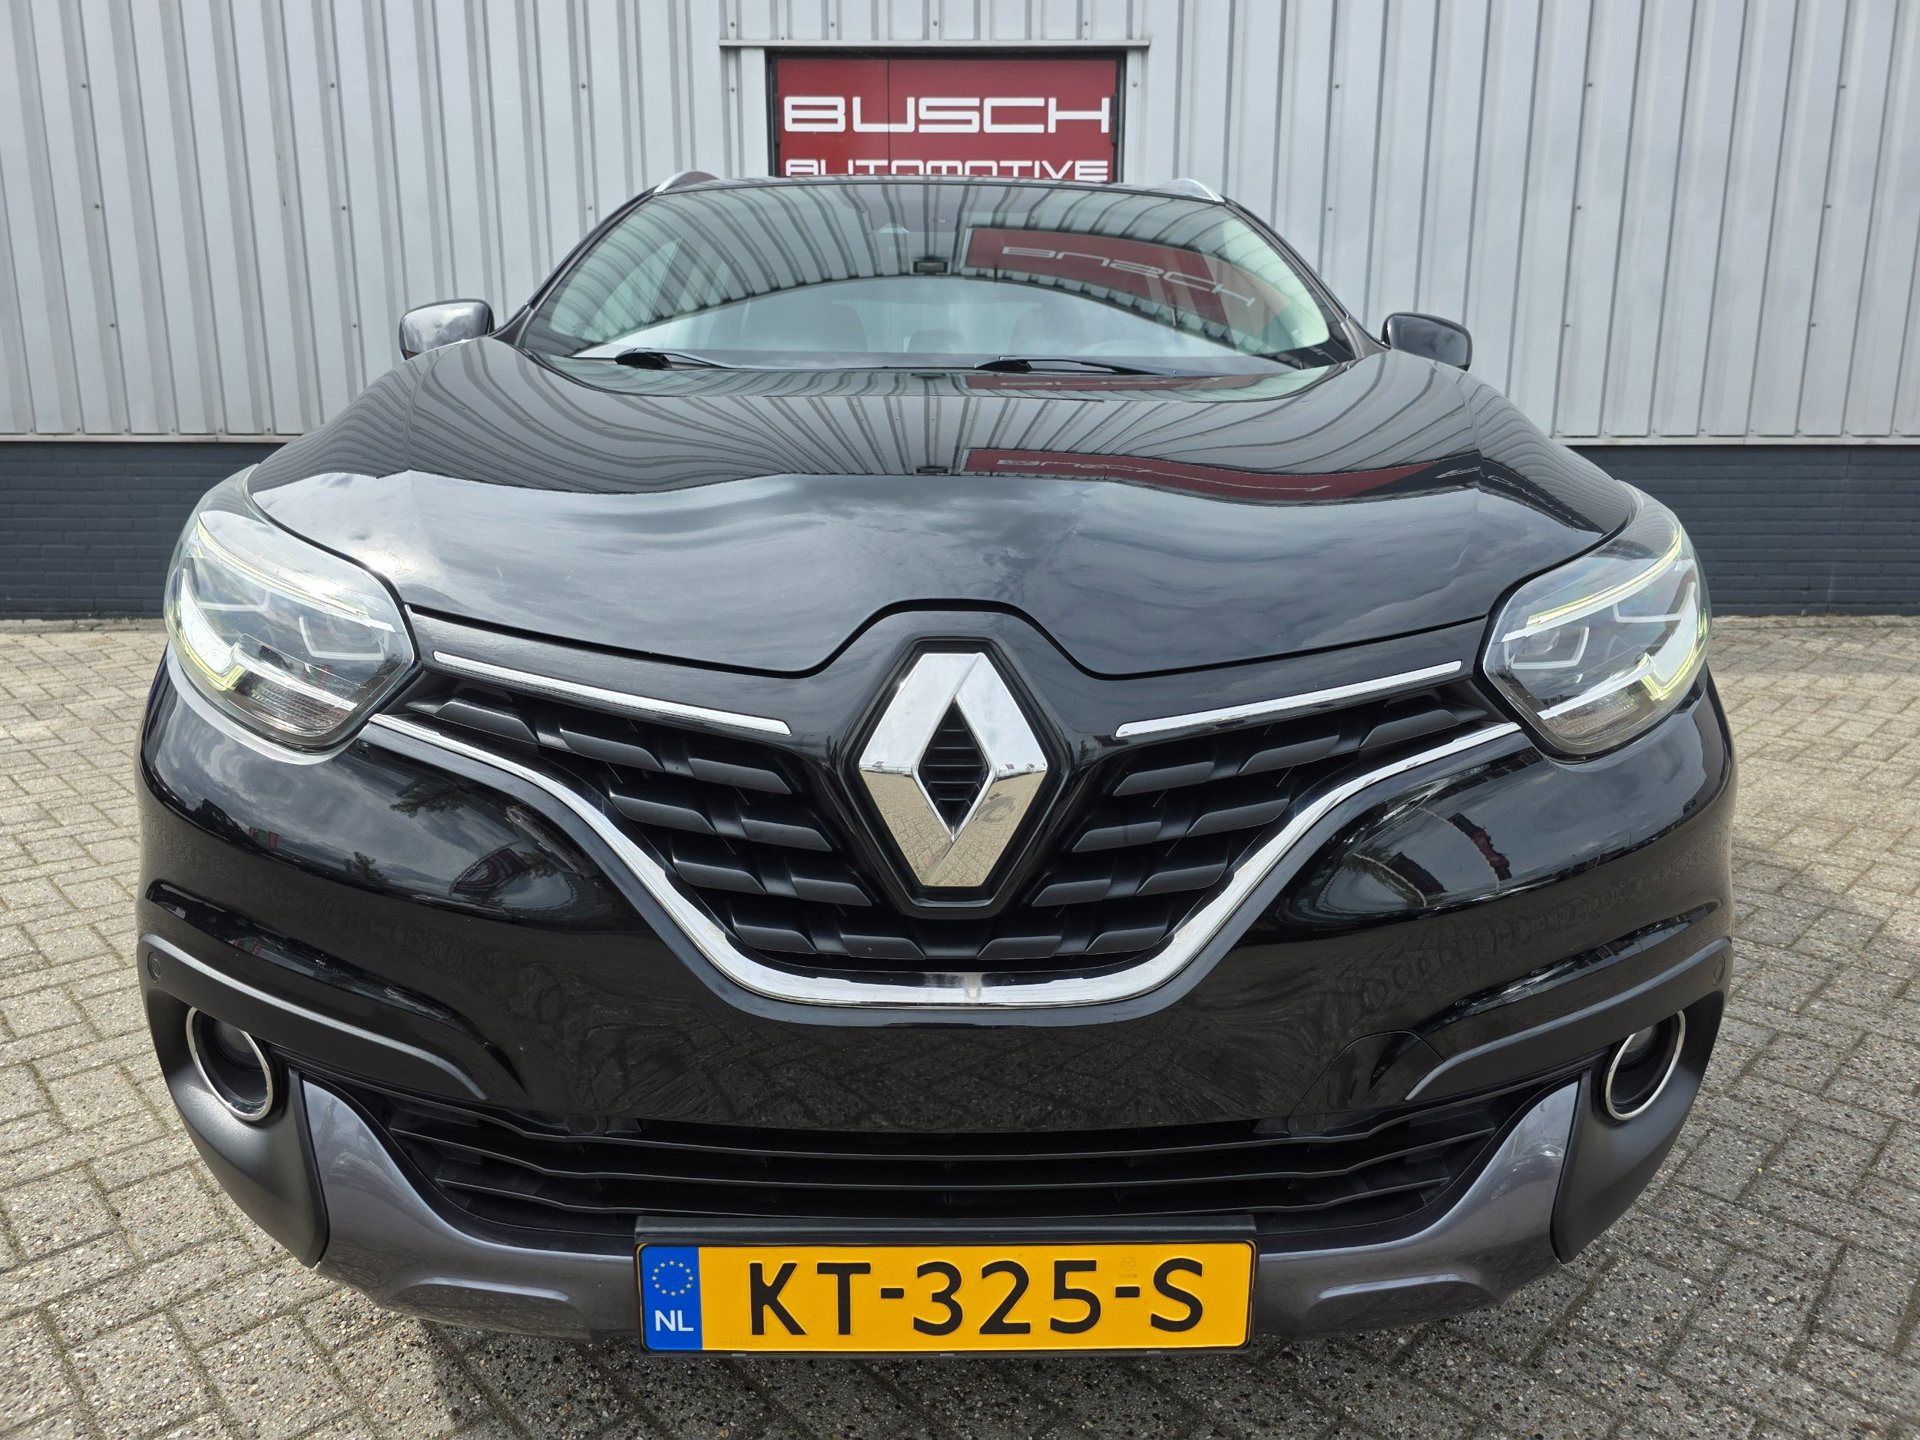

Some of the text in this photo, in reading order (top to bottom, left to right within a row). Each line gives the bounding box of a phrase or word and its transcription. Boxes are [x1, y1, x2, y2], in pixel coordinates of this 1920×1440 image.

[784, 97, 1109, 133] BUSCH
[785, 159, 1109, 180] AUTOMOTIVE
[750, 1258, 1203, 1336] KT-325-S
[655, 1310, 694, 1332] NL
